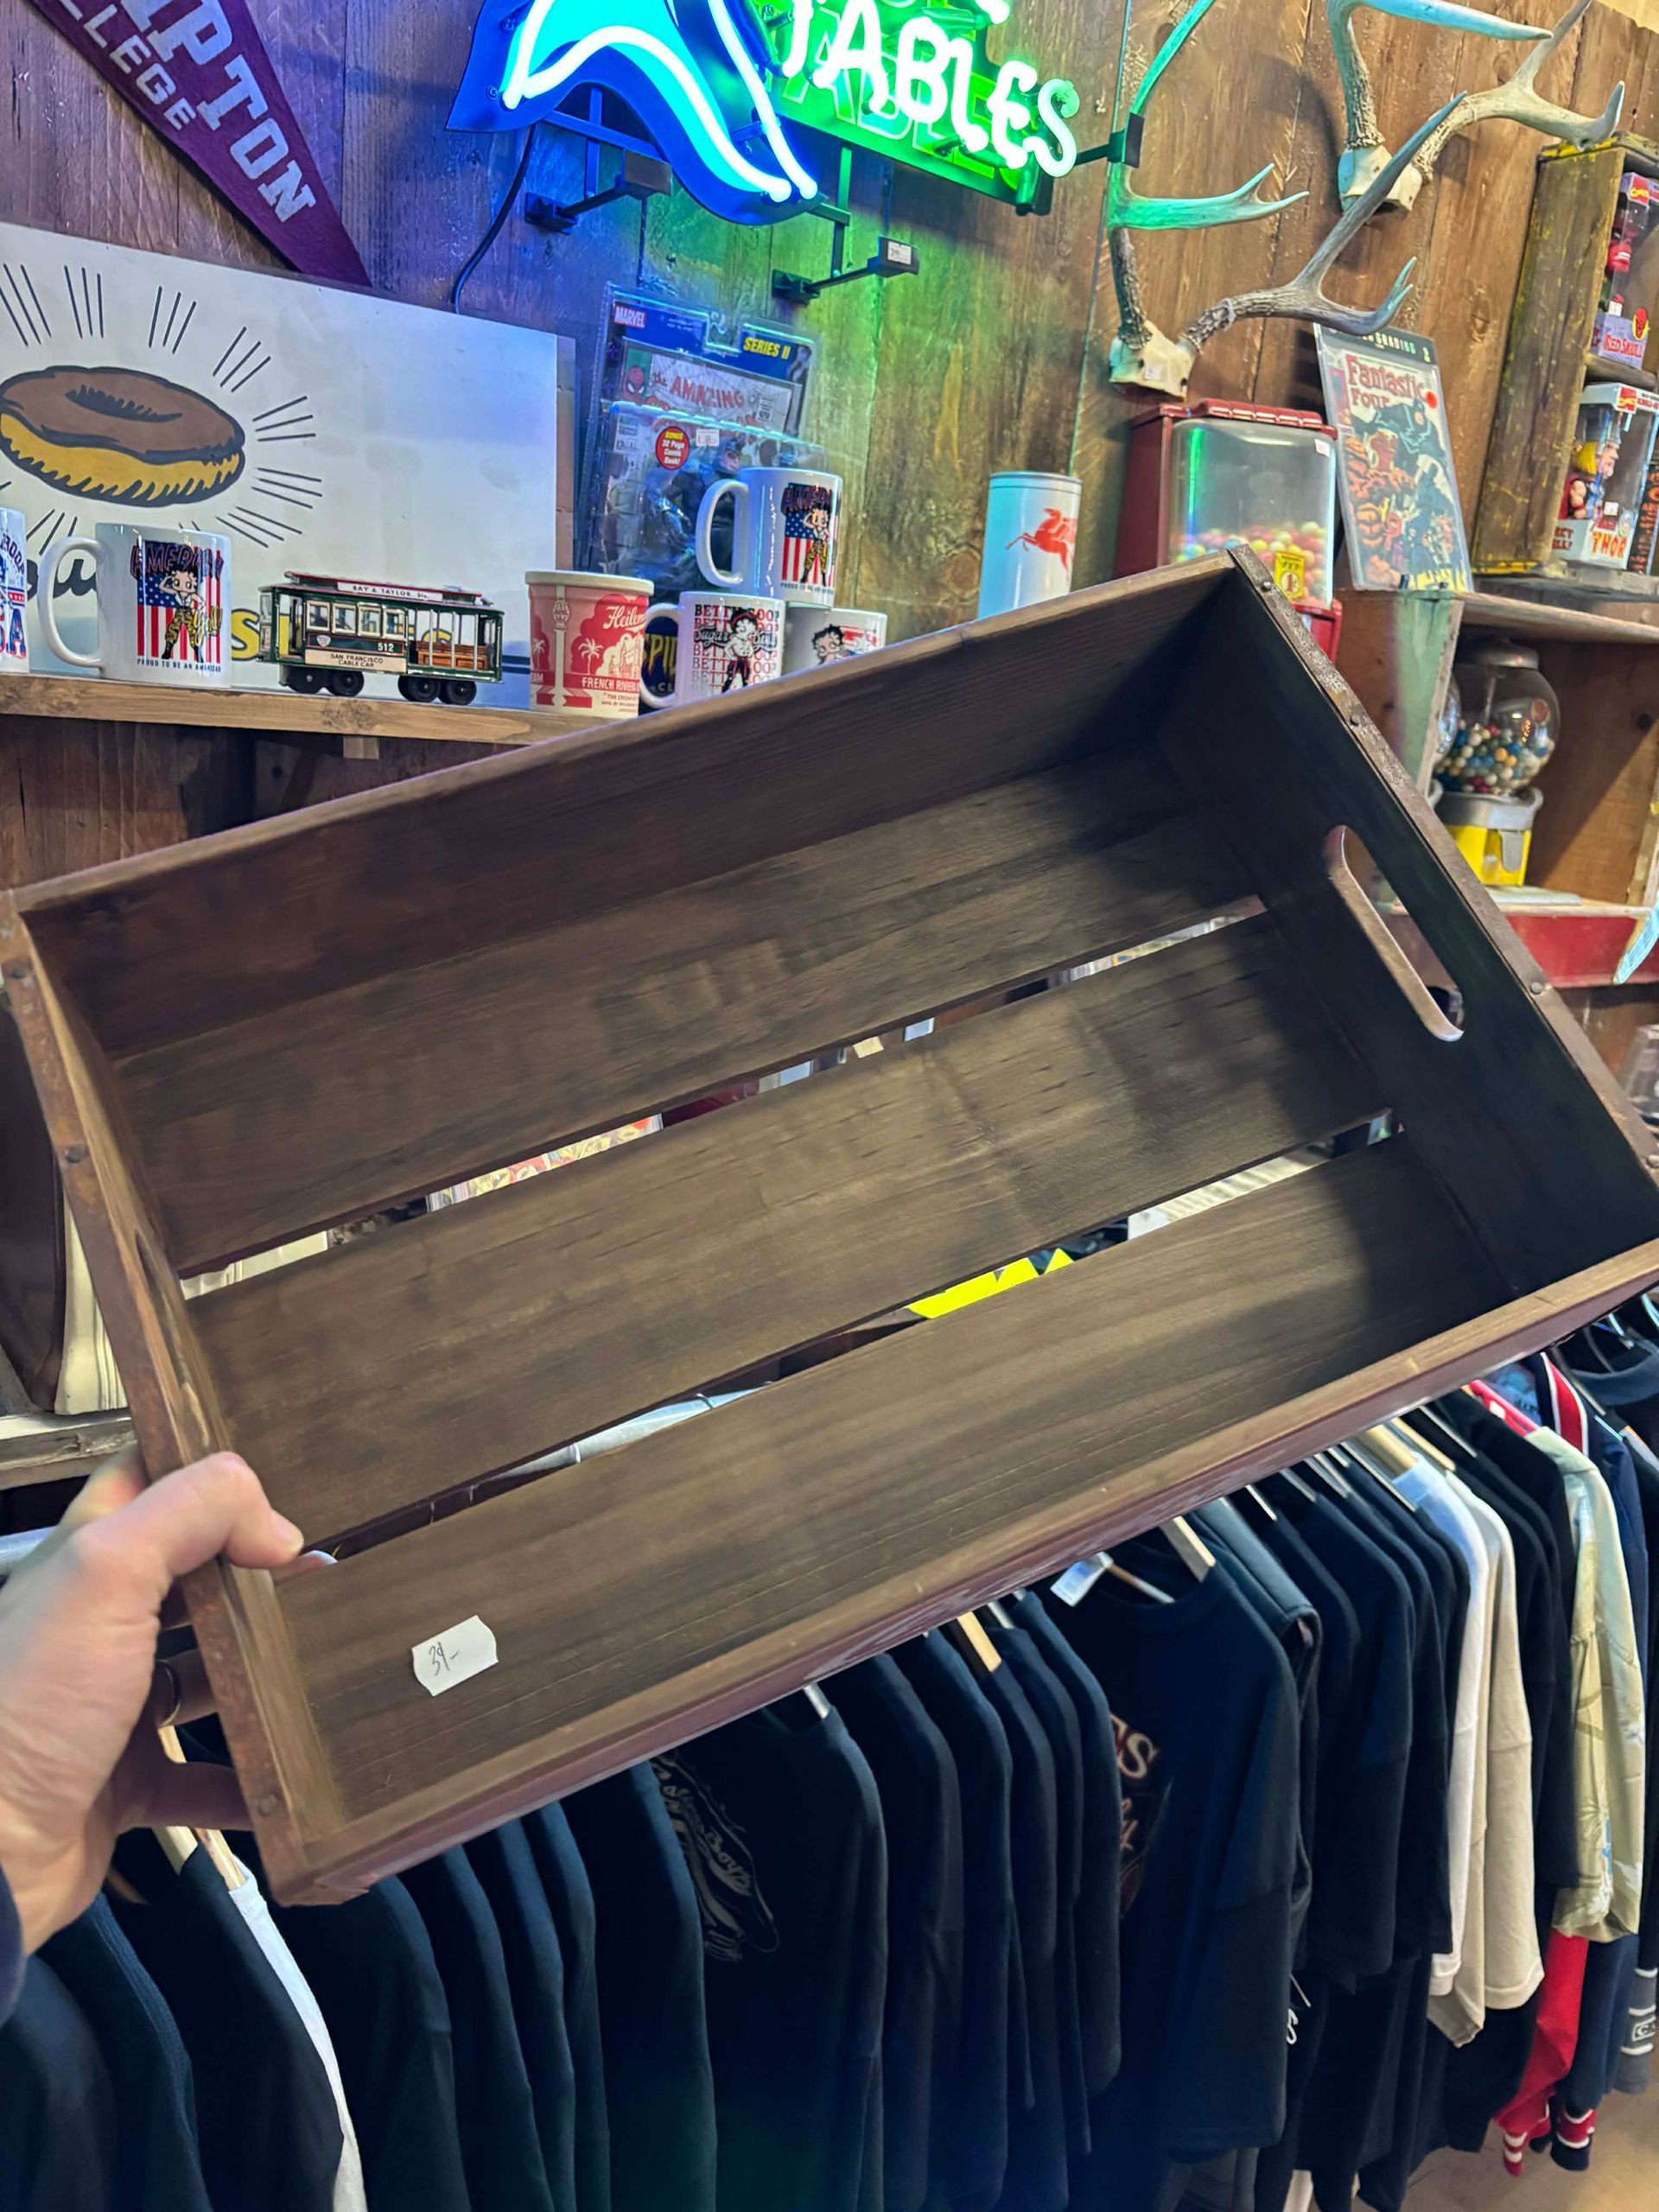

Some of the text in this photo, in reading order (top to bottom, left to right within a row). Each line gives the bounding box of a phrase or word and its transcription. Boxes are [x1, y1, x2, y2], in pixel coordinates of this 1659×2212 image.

[614, 306, 646, 328] MARVEL
[743, 336, 779, 357] SERIES
[1345, 355, 1427, 402] Fantastic
[670, 375, 745, 408] AMAZING
[353, 584, 368, 593] BAY
[381, 588, 411, 597] TAYLOR
[377, 642, 395, 652] 512
[694, 627, 730, 651] Sugar
[137, 658, 159, 667] PROUD
[582, 677, 614, 690] FRENCH
